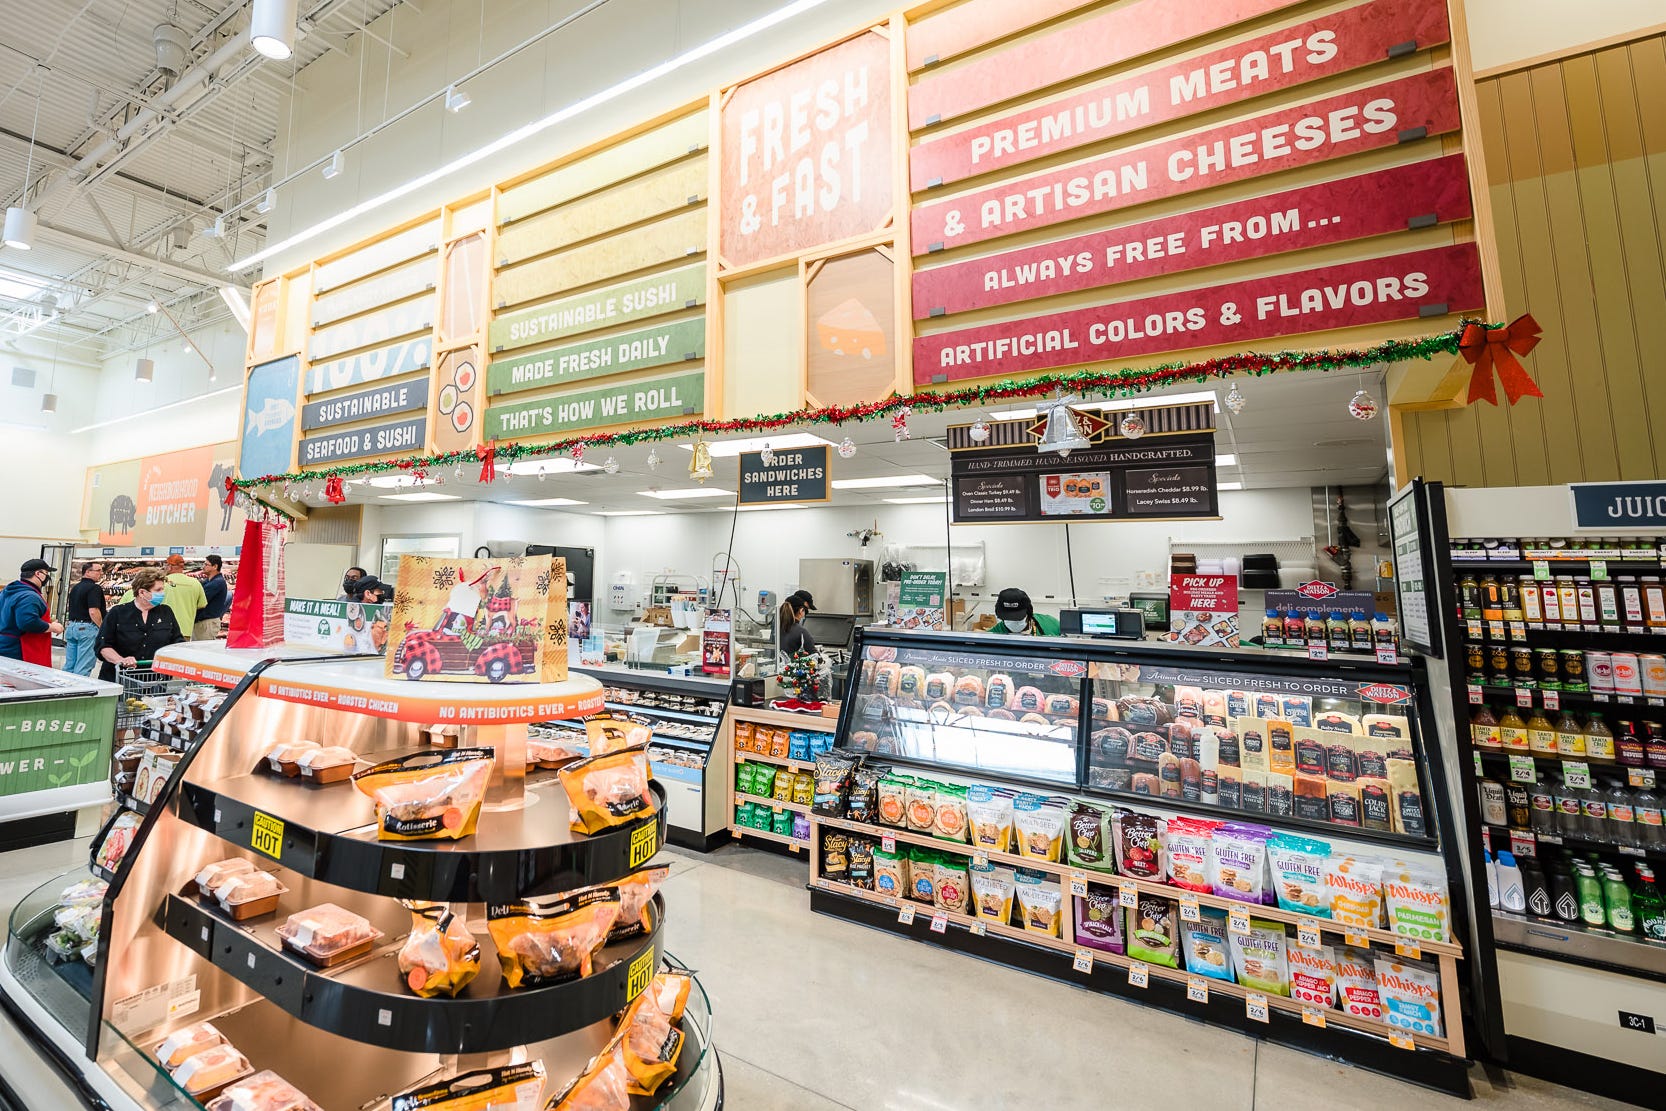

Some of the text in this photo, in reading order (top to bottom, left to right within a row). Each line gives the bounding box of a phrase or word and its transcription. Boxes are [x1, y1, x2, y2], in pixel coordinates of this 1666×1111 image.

[972, 30, 1338, 163] PREMIUM MEATS
[741, 66, 868, 187] FRESH
[944, 99, 1397, 237] & ARTISAN CHEESES
[740, 121, 868, 235] & FAST
[985, 252, 1093, 291] ALWAYS
[1108, 232, 1185, 267] FREE
[510, 283, 676, 340] SUSTAINABLE SUSHI
[941, 272, 1428, 366] ARTIFICIAL COLORS & FLAVORS
[512, 336, 669, 384] MADE FRESH DAILY
[320, 388, 407, 422] SUSTAINABLE
[501, 387, 682, 431] THAT'S HOW WE ROLL
[307, 425, 416, 459] SEAFOOD & SUSHI
[1110, 450, 1192, 462] HANDCRAFTED.
[745, 468, 822, 483] SANDWICHES
[150, 479, 198, 500] NEIGHBORHOOD
[768, 485, 798, 496] HERE
[146, 503, 195, 524] BUTCHER
[1183, 578, 1224, 586] PICK UP
[290, 600, 341, 616] MAKE IT A MEAL!
[1190, 599, 1217, 607] HERE
[1276, 603, 1365, 614] deli complements
[1015, 662, 1044, 670] ORDER
[1202, 676, 1240, 686] SLICED
[1244, 678, 1281, 689] FRESH
[1283, 682, 1299, 690] TO
[1303, 683, 1347, 694] ORDER
[269, 684, 398, 714] NO ANTIBIOTICS EVER ROASTED CHICKEN
[1366, 691, 1399, 699] WATSON
[439, 706, 455, 718] NO
[459, 705, 534, 718] ANTIBIOTICS
[538, 703, 564, 716] EVER
[814, 761, 849, 781] Stacy's
[1365, 798, 1386, 807] COLBY
[1369, 804, 1386, 813] JACK
[396, 818, 437, 831] Rotisserie
[1074, 820, 1097, 829] Better
[256, 829, 278, 854] HOT
[1126, 829, 1153, 838] Better
[634, 836, 654, 864] HOT
[1168, 844, 1190, 854] GLUTEN
[1215, 848, 1255, 863] GLUTEN FREE
[1277, 860, 1320, 876] GLUTEN FREE
[1328, 873, 1377, 895] Whisps
[1389, 884, 1443, 904] Whisps
[1140, 901, 1166, 911] Better
[1398, 912, 1439, 926] PARMESAN
[1187, 922, 1224, 937] GLUTEN FREE
[1238, 937, 1279, 952] GLUTEN FREE
[1287, 949, 1333, 970] Whisps
[1337, 962, 1375, 982] Whisp
[631, 964, 651, 997] HOT
[1296, 980, 1316, 990] PEPPER
[1381, 973, 1434, 998] Whisps
[1350, 994, 1371, 1003] PEPPER
[1629, 1016, 1646, 1028] 3C-1
